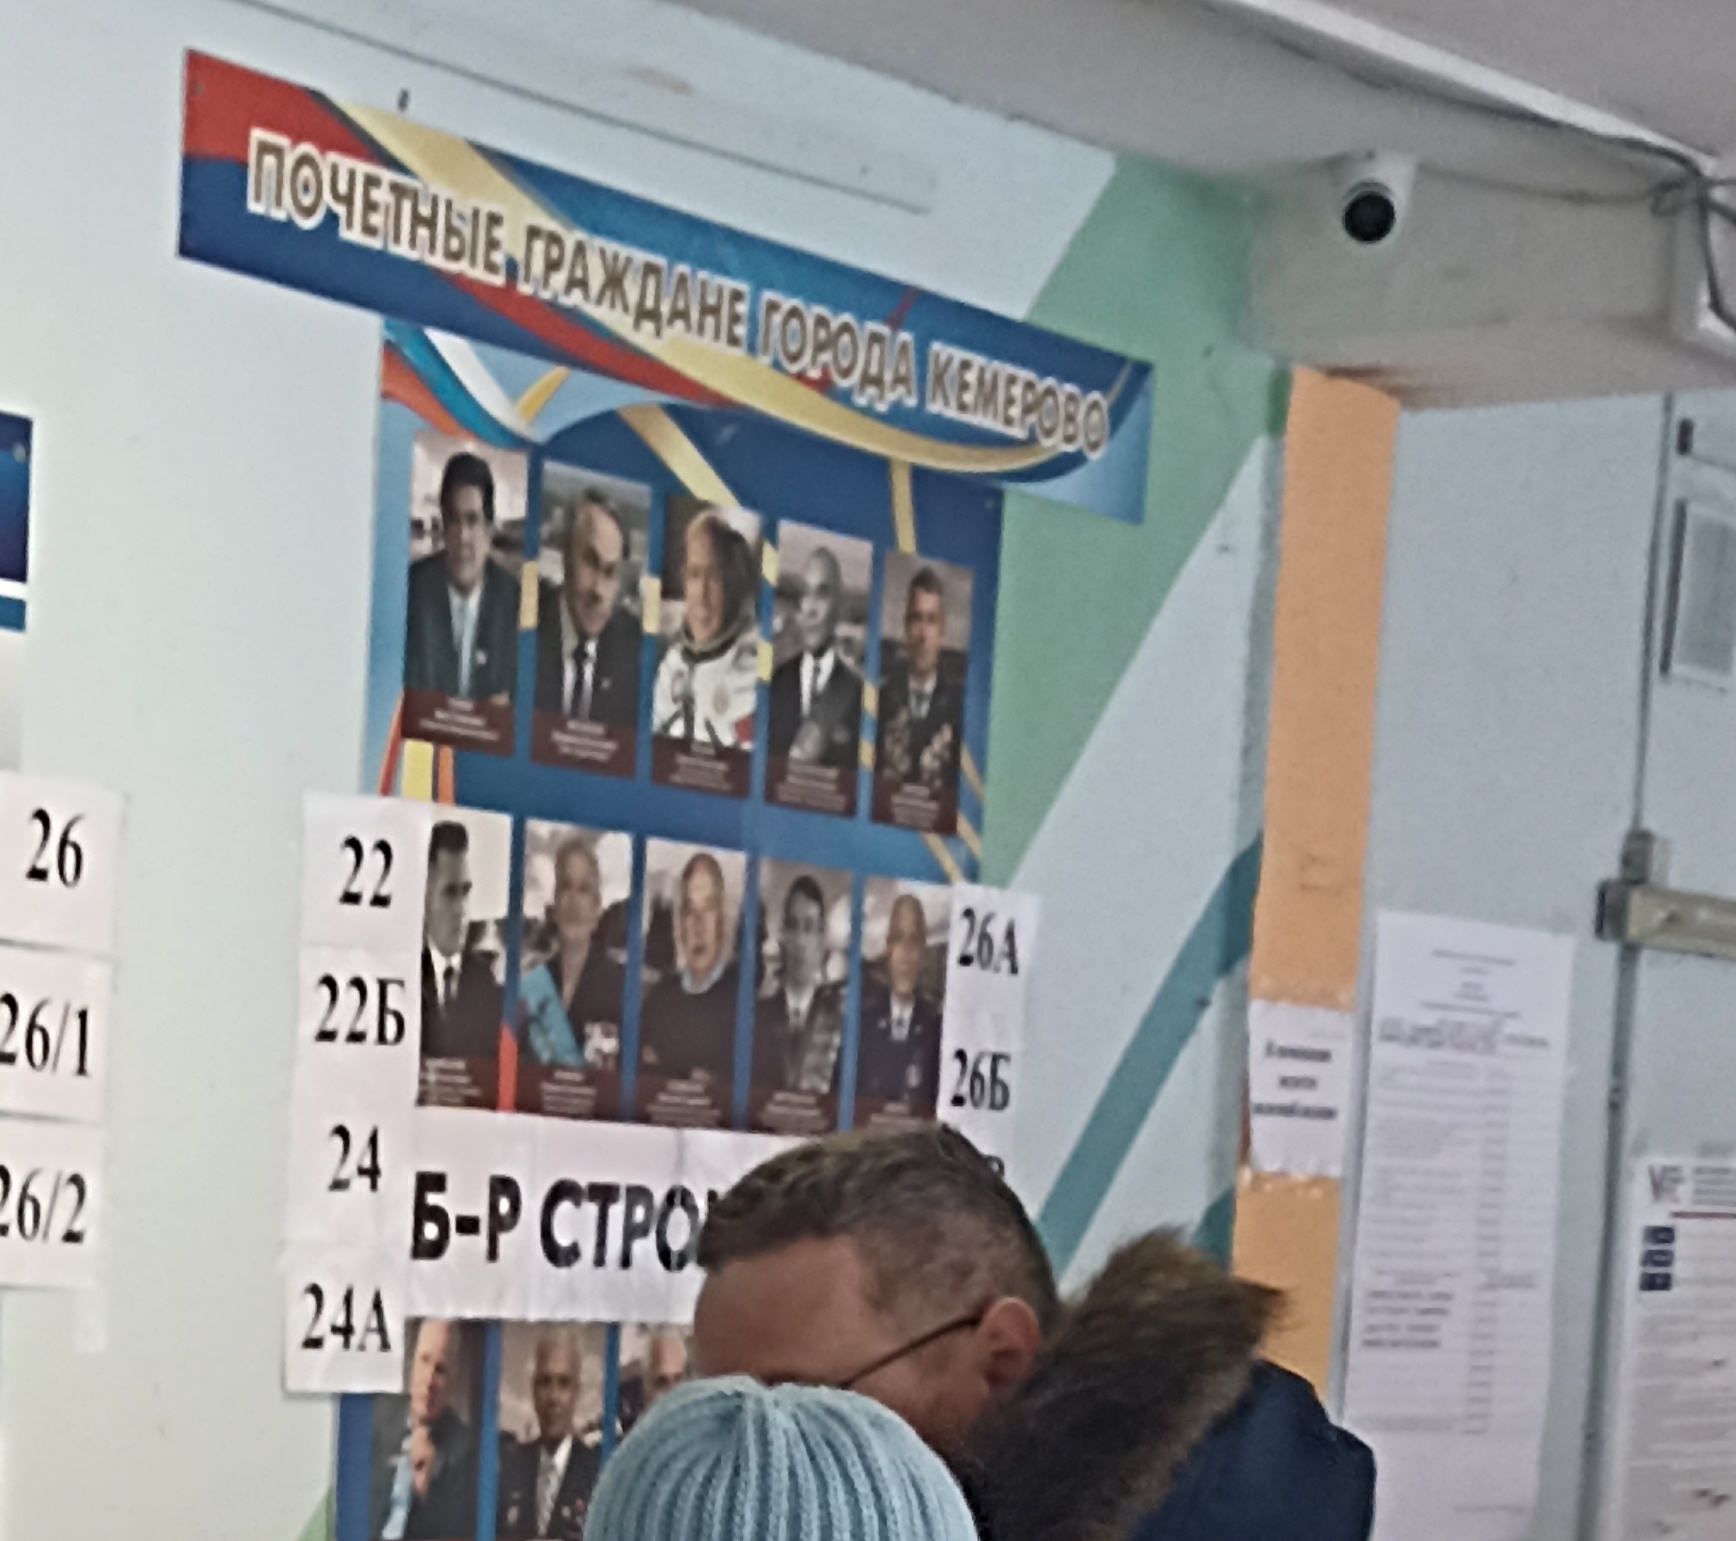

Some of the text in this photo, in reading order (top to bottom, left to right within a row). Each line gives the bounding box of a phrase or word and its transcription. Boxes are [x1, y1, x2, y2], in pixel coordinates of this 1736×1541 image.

[250, 130, 1107, 454] ПОЧЕТНЫЕ ГРАЖДАНЕ ГОРОДА КЕМЕРОВО
[26, 807, 85, 888] 26
[338, 835, 393, 908] 22
[958, 907, 1019, 976] 26А
[314, 972, 406, 1046] 22Б
[951, 1048, 1012, 1112] 26Б
[328, 1124, 382, 1193] 24
[410, 1171, 717, 1273] Б-Р СТРО
[301, 1282, 391, 1353] 24А
